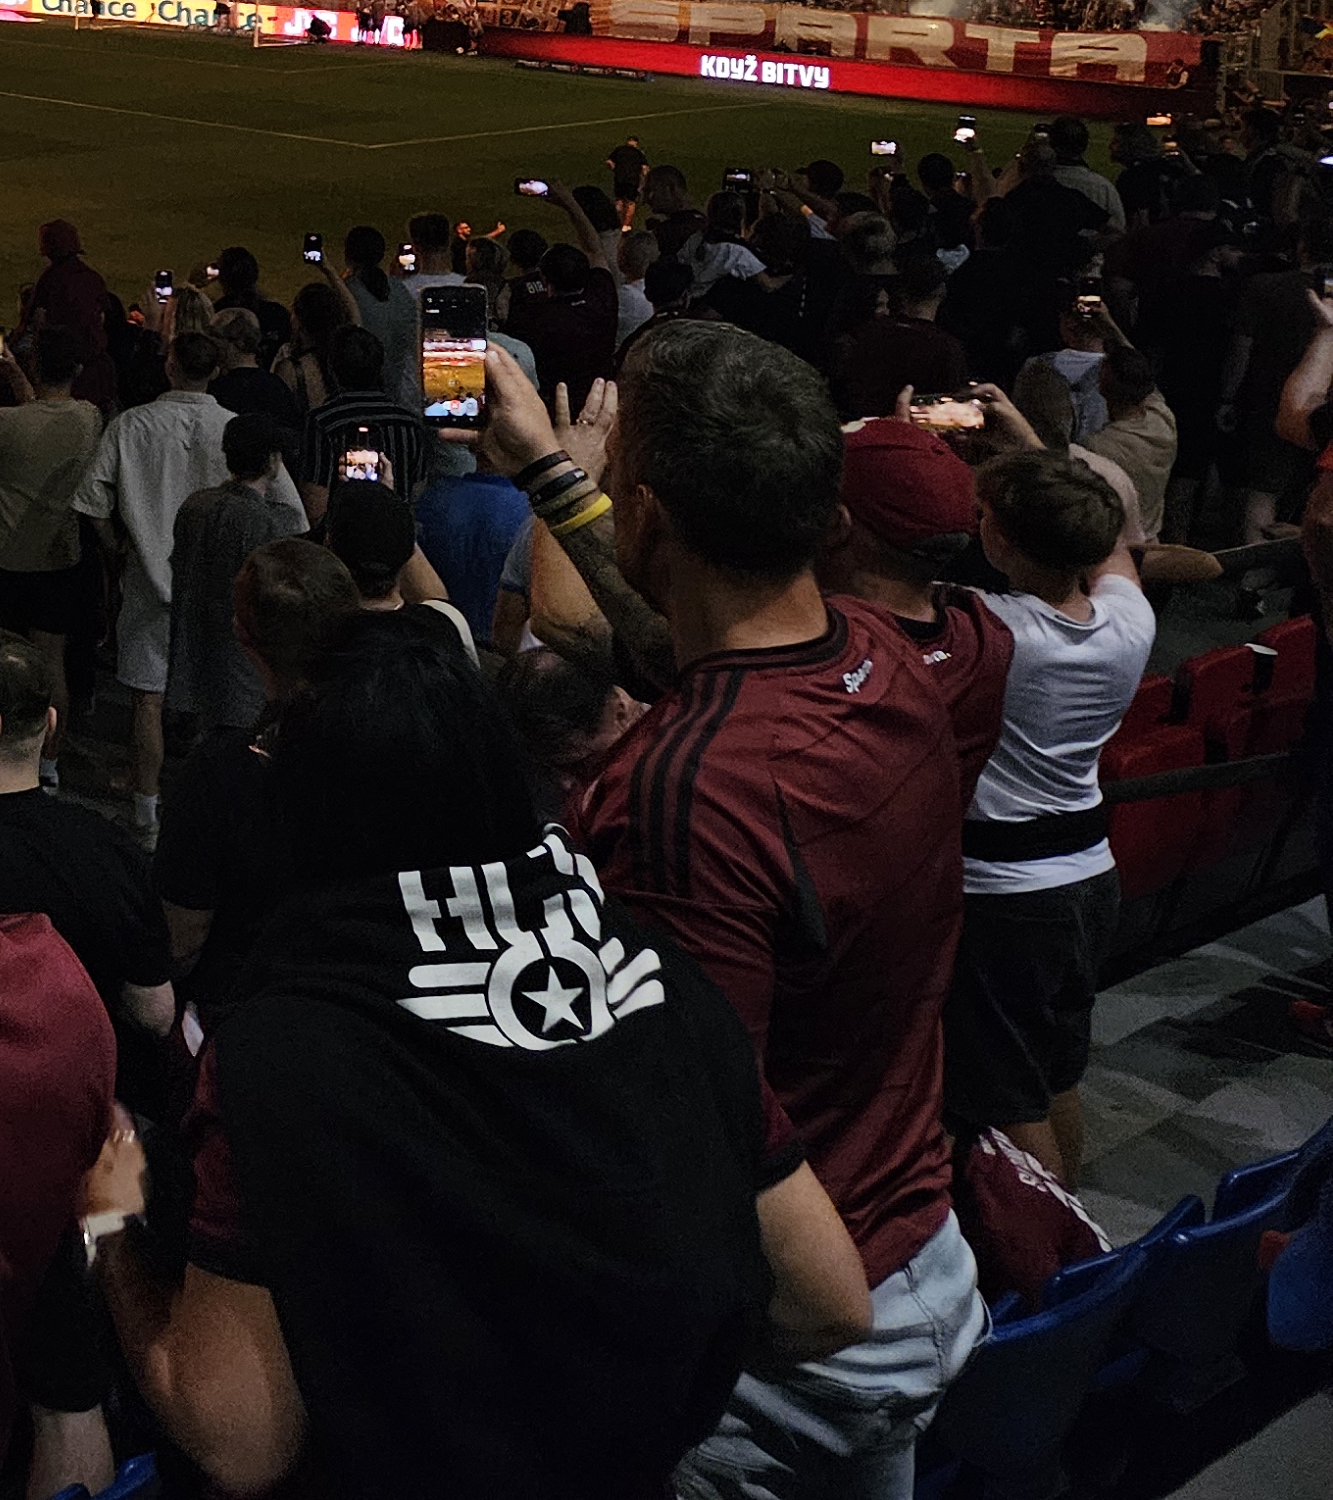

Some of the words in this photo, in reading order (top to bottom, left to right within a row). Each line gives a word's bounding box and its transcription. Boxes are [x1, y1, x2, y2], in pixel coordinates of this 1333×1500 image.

[609, 0, 1148, 82] SPARTA
[701, 54, 758, 81] KDYŽ
[762, 62, 830, 88] BITVY
